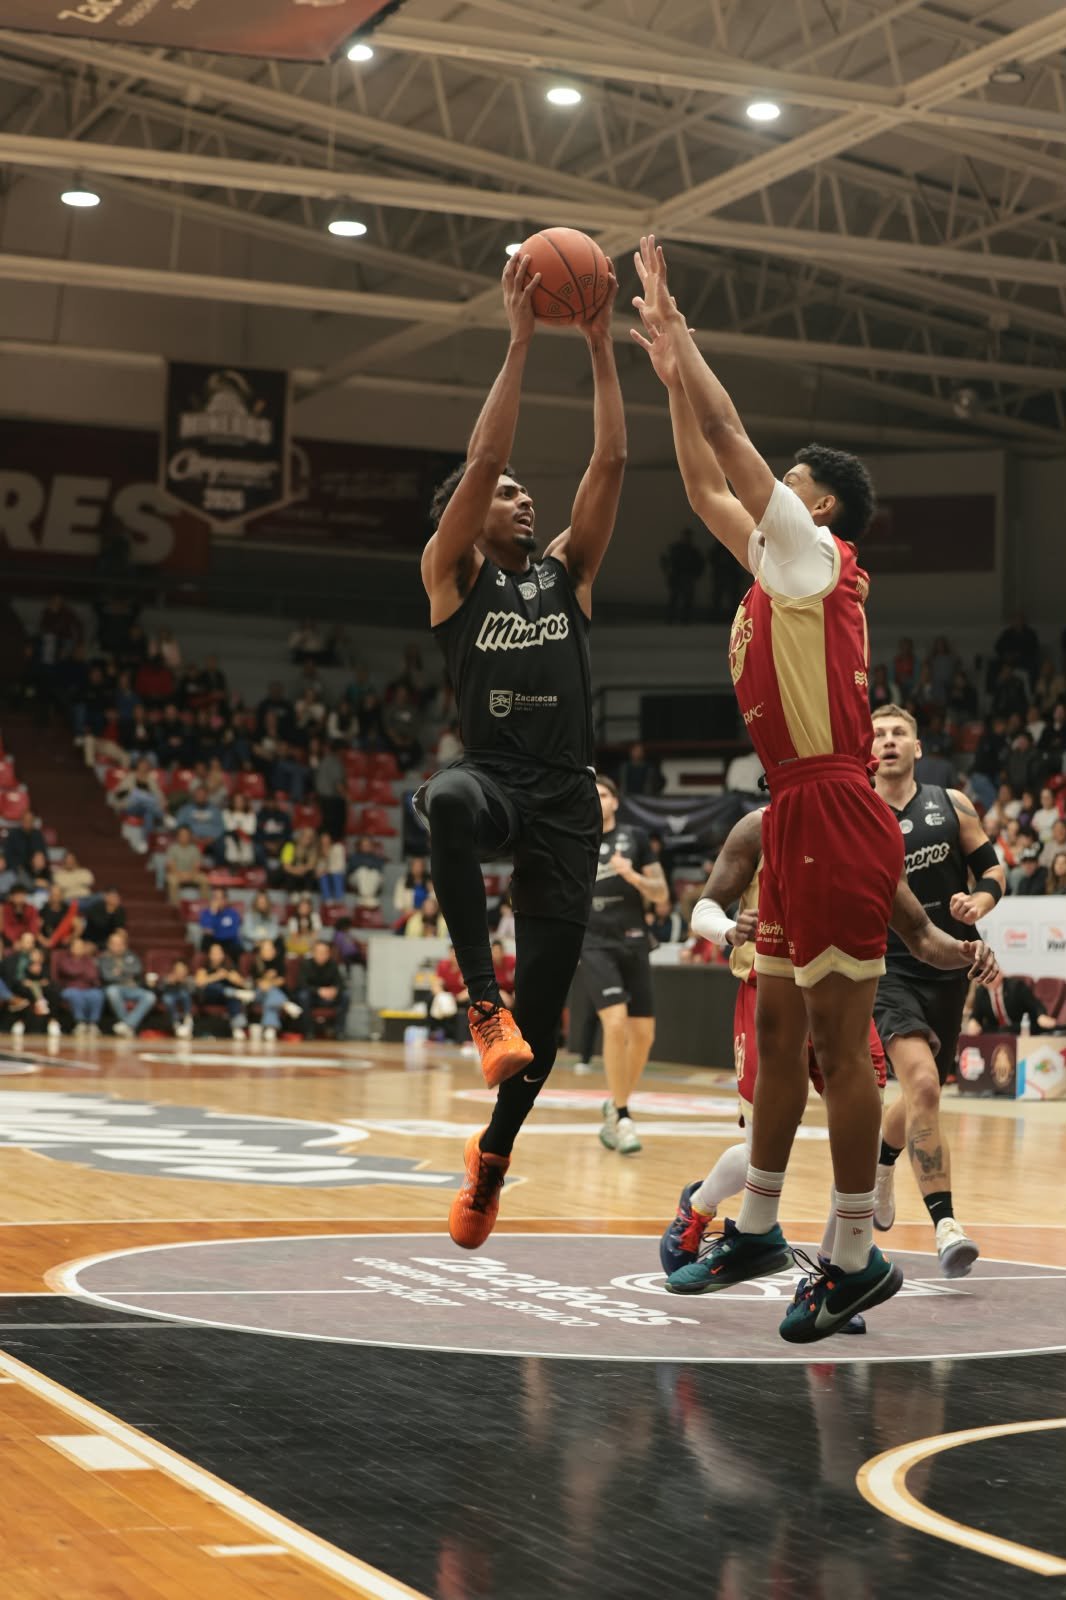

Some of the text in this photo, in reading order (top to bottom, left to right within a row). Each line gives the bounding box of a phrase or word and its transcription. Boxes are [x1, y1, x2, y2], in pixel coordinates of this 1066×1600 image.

[0, 469, 181, 564] RES
[475, 611, 569, 652] Minros
[514, 693, 558, 702] Zacatecas
[904, 842, 951, 874] neros
[409, 1256, 701, 1326] Zacatecas
[448, 1288, 509, 1301] DEL
[491, 1301, 601, 1327] ESTADO
